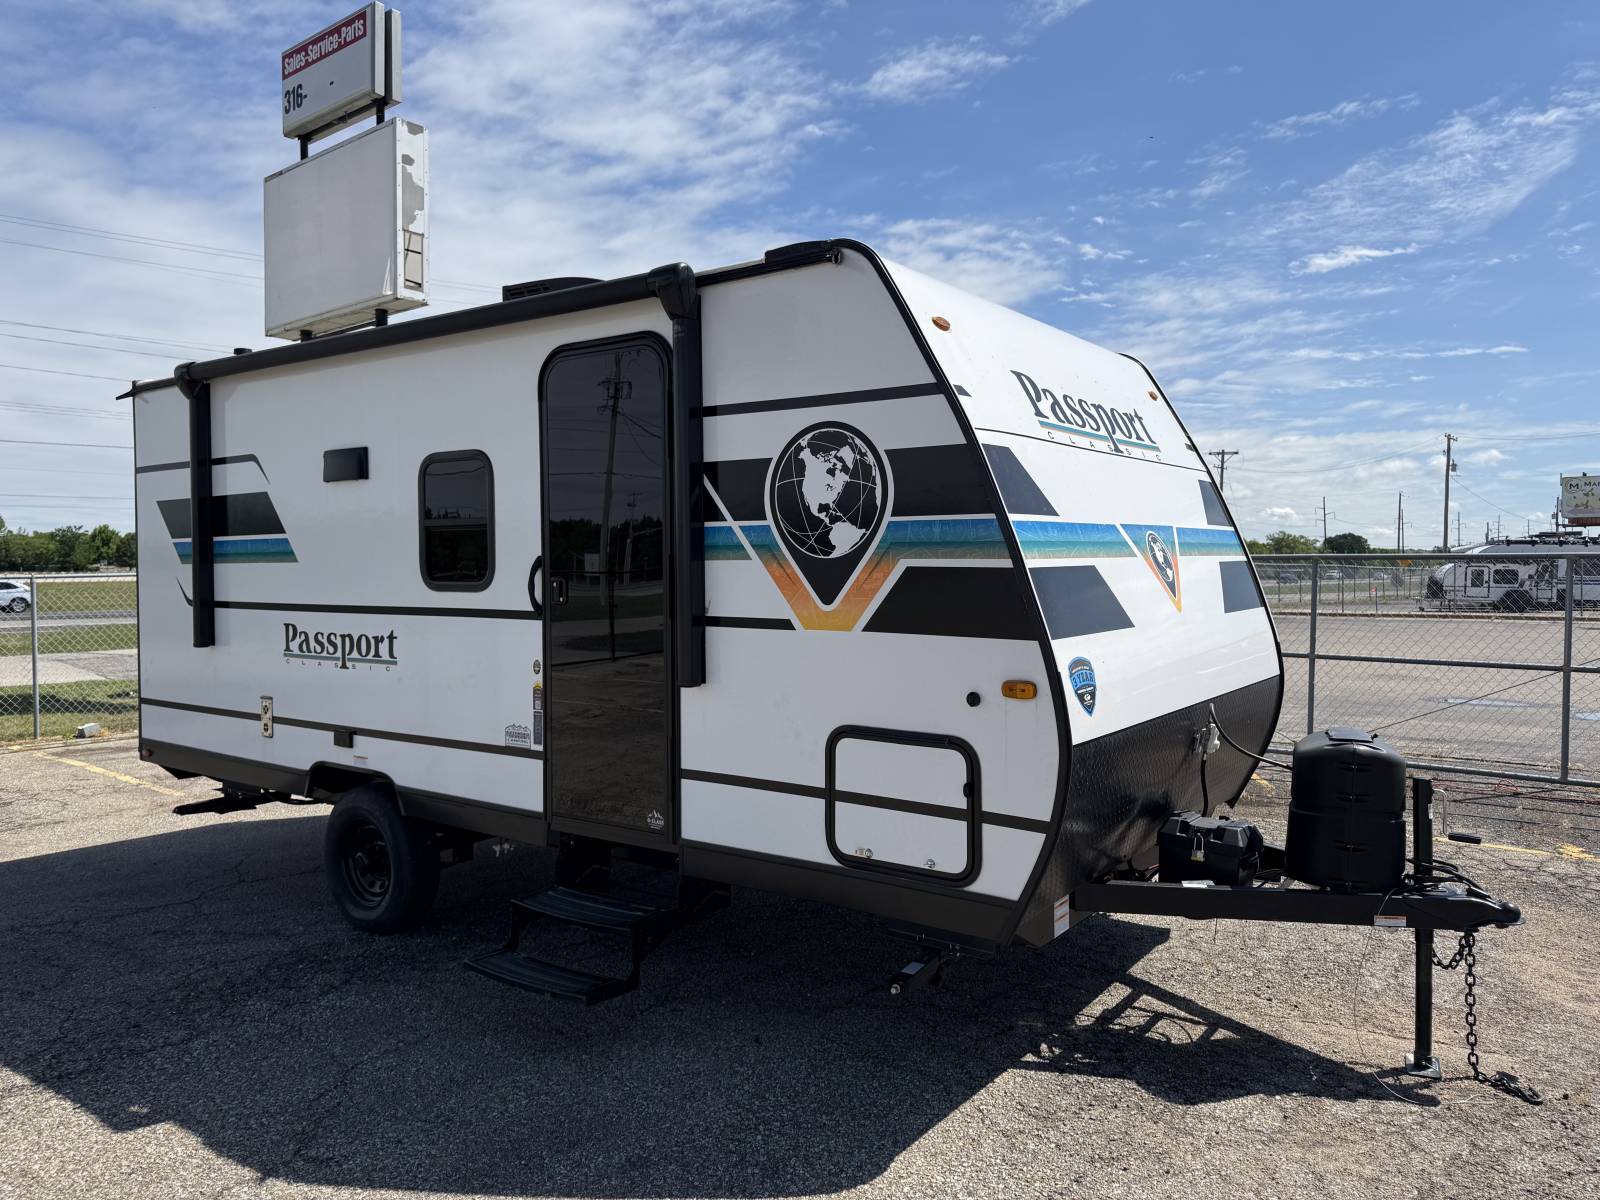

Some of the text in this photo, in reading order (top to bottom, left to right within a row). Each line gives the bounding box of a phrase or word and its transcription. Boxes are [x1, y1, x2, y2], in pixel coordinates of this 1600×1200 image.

[284, 19, 364, 75] Sales-Service-Parts
[1009, 369, 1157, 453] Passport
[1047, 431, 1162, 461] CLASSIC
[283, 622, 398, 669] Passport
[285, 658, 391, 672] CLASSIC
